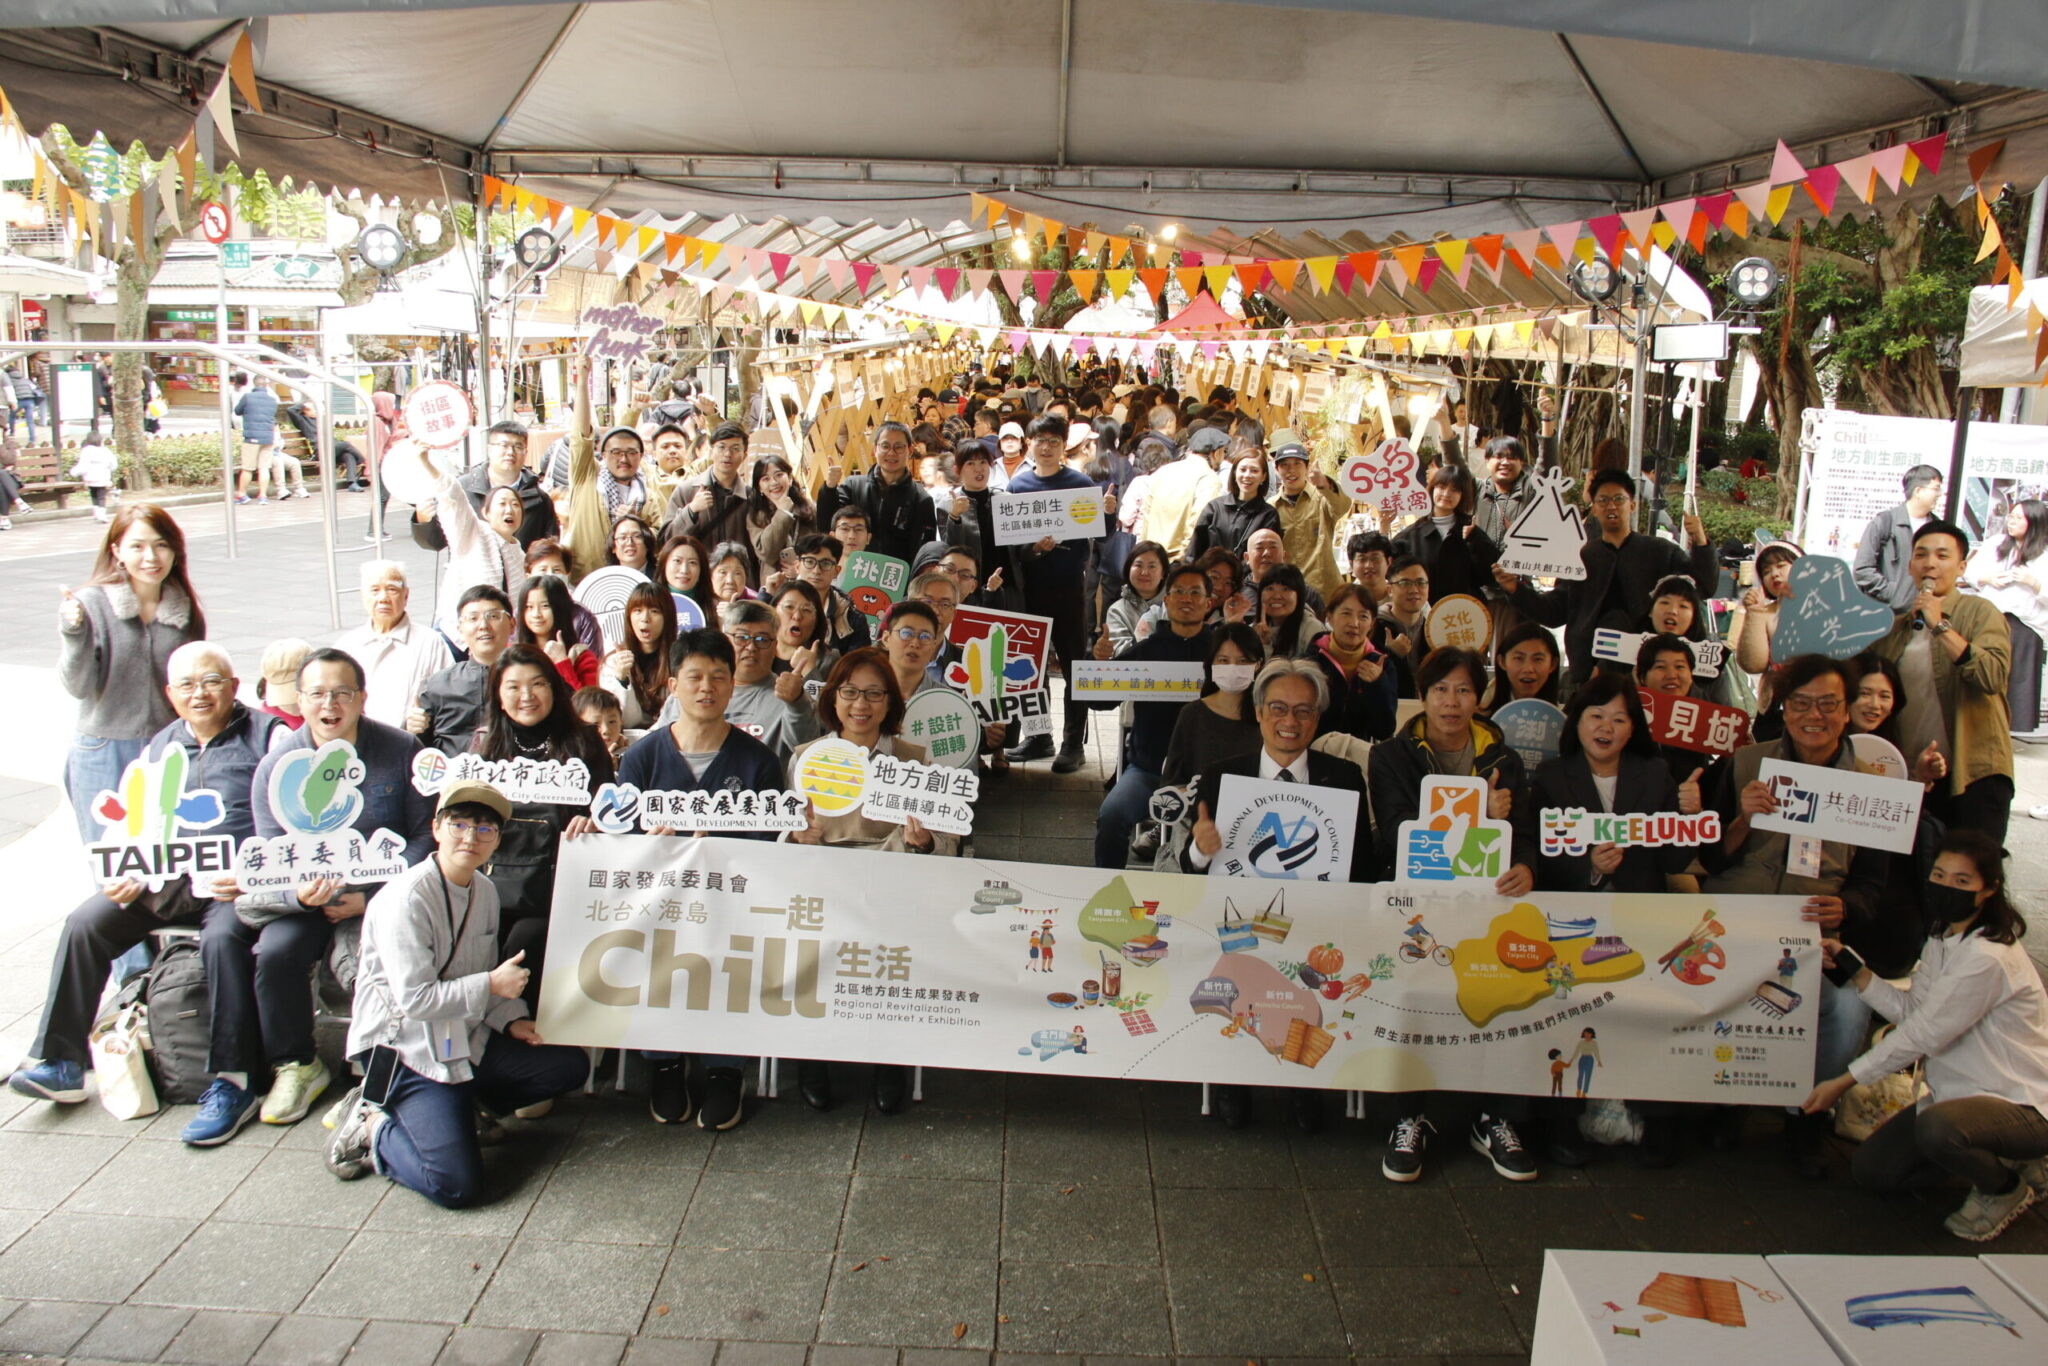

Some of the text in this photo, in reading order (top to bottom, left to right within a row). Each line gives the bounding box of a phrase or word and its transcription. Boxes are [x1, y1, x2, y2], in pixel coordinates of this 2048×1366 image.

[420, 395, 451, 417] 街區
[425, 412, 456, 434] 故事
[1969, 455, 2048, 477] 地方商品銷
[999, 498, 1063, 518] 地方創生
[1381, 491, 1428, 511] 蟻窩
[1000, 517, 1064, 532] 北區輔導中心
[852, 556, 905, 592] 桃園
[1442, 610, 1472, 630] 文化
[1078, 677, 1103, 688] 陪伴
[971, 691, 1048, 723] AIPEI
[928, 712, 962, 736] 設計
[1665, 700, 1743, 753] 見域
[931, 734, 967, 758] 翻轉
[323, 767, 360, 782] OAC
[456, 758, 587, 791] 新北市政府
[874, 760, 978, 798] 地方創生
[511, 792, 530, 800] City
[534, 793, 588, 803] Government
[646, 795, 804, 816] 國家發展委員會
[868, 791, 969, 822] 北區輔導中心
[1822, 791, 1914, 825] 共創設計
[696, 818, 757, 828] DEVELOPMENT
[765, 818, 804, 828] COUNCIL
[1225, 793, 1340, 863] NATIONAL DEVELOPMENT COUNCIL
[1594, 815, 1717, 844] KEELUNG
[92, 840, 231, 878] TAIPEI
[243, 837, 400, 871] 海洋委員會
[247, 864, 403, 887] Ocean Affairs Council
[588, 869, 749, 893] 國家發展委員會
[750, 894, 825, 932] 一起
[1387, 896, 1413, 907] Chill
[836, 941, 913, 982] 生活
[578, 929, 827, 1019] Chill
[834, 982, 980, 1003] 北區地方創生成果發表會
[834, 998, 961, 1015] Regional Revitalization
[833, 1010, 873, 1021] Pop-up
[877, 1013, 914, 1023] Market
[928, 1016, 981, 1027] Exhibition
